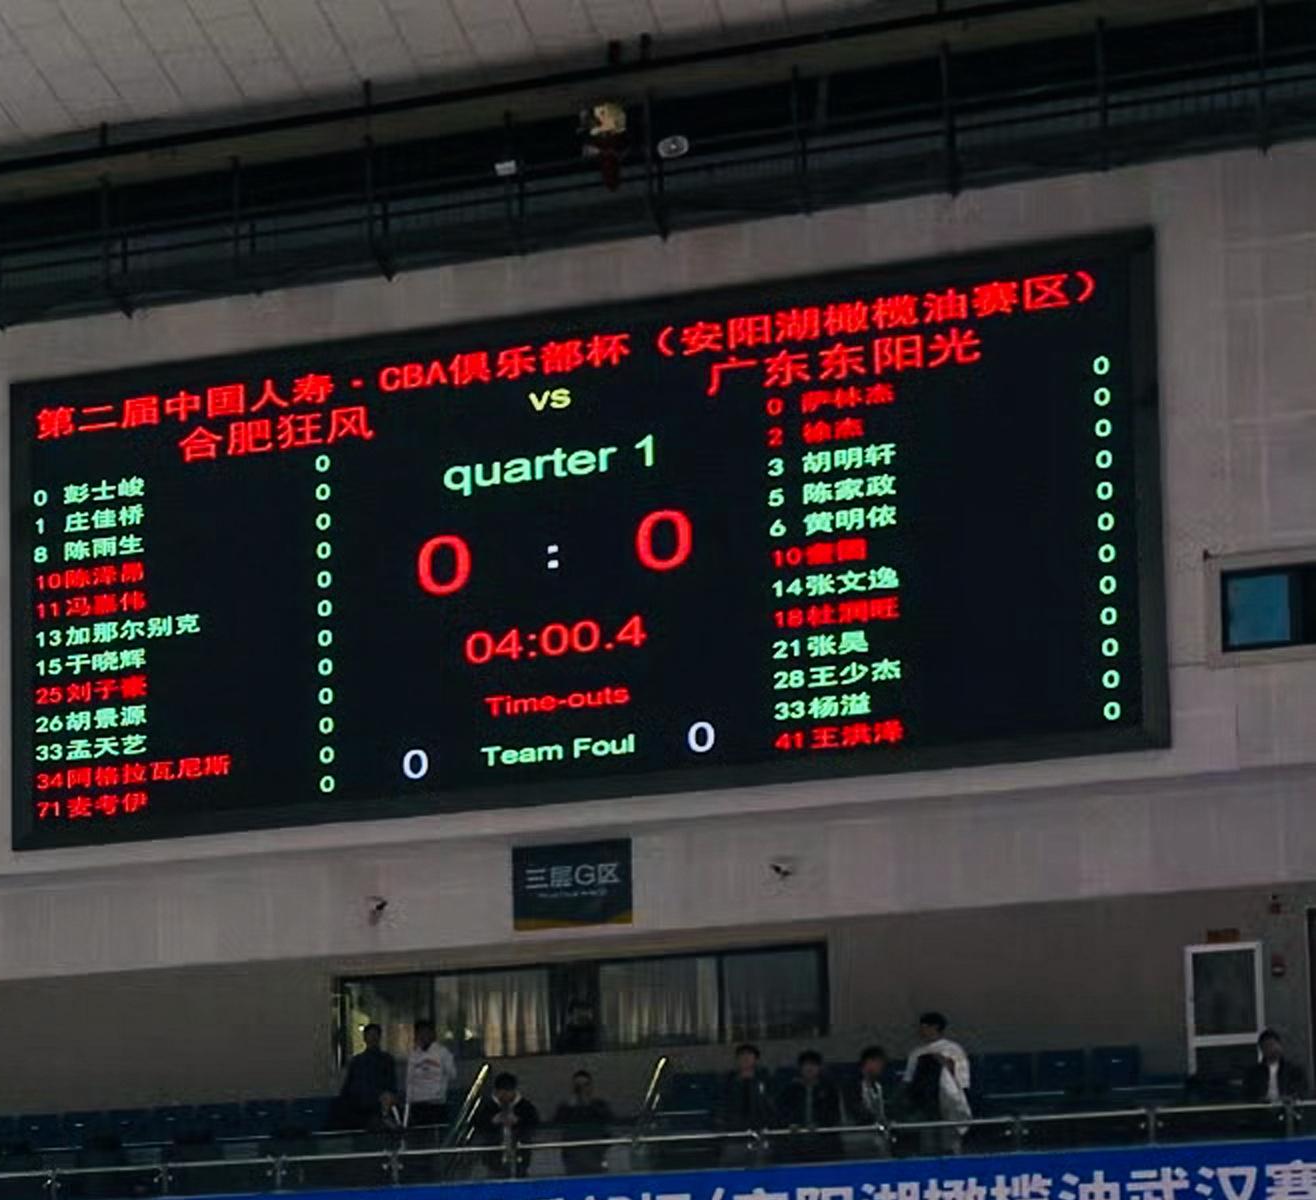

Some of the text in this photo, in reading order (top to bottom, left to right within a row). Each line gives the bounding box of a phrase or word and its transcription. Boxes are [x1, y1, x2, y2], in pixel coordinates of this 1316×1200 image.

[708, 328, 981, 396] 广东东阳光
[1093, 355, 1110, 375] 0
[1094, 387, 1111, 407] 0
[179, 405, 375, 463] 合肥狂风
[767, 457, 785, 477] 3
[1095, 418, 1112, 438] 0
[443, 434, 654, 497] quarter 1
[33, 489, 48, 507] 0
[315, 454, 331, 473] 0
[768, 487, 785, 507] 5
[1096, 449, 1113, 469] 0
[35, 517, 45, 535] 1
[315, 483, 331, 502] 0
[769, 518, 787, 537] 6
[1097, 481, 1114, 501] 0
[1098, 511, 1115, 531] 0
[33, 545, 49, 564] 8
[315, 512, 331, 531] 0
[316, 541, 332, 560] 0
[418, 535, 472, 595] 0
[636, 510, 691, 570] 0
[1099, 543, 1116, 563] 0
[316, 570, 332, 589] 0
[1100, 575, 1117, 595] 0
[316, 599, 332, 618] 0
[1101, 606, 1118, 626] 0
[317, 629, 333, 648] 0
[464, 614, 648, 664] 04:00.4
[1102, 637, 1119, 657] 0
[317, 657, 333, 676] 0
[1103, 669, 1120, 689] 0
[317, 687, 333, 706] 0
[484, 686, 630, 717] Time-outs
[1103, 701, 1120, 721] 0
[318, 716, 334, 735] 0
[687, 721, 715, 753] 0
[318, 746, 334, 765] 0
[480, 733, 636, 767] Team Foul
[403, 750, 429, 780] 0
[318, 775, 334, 794] 0
